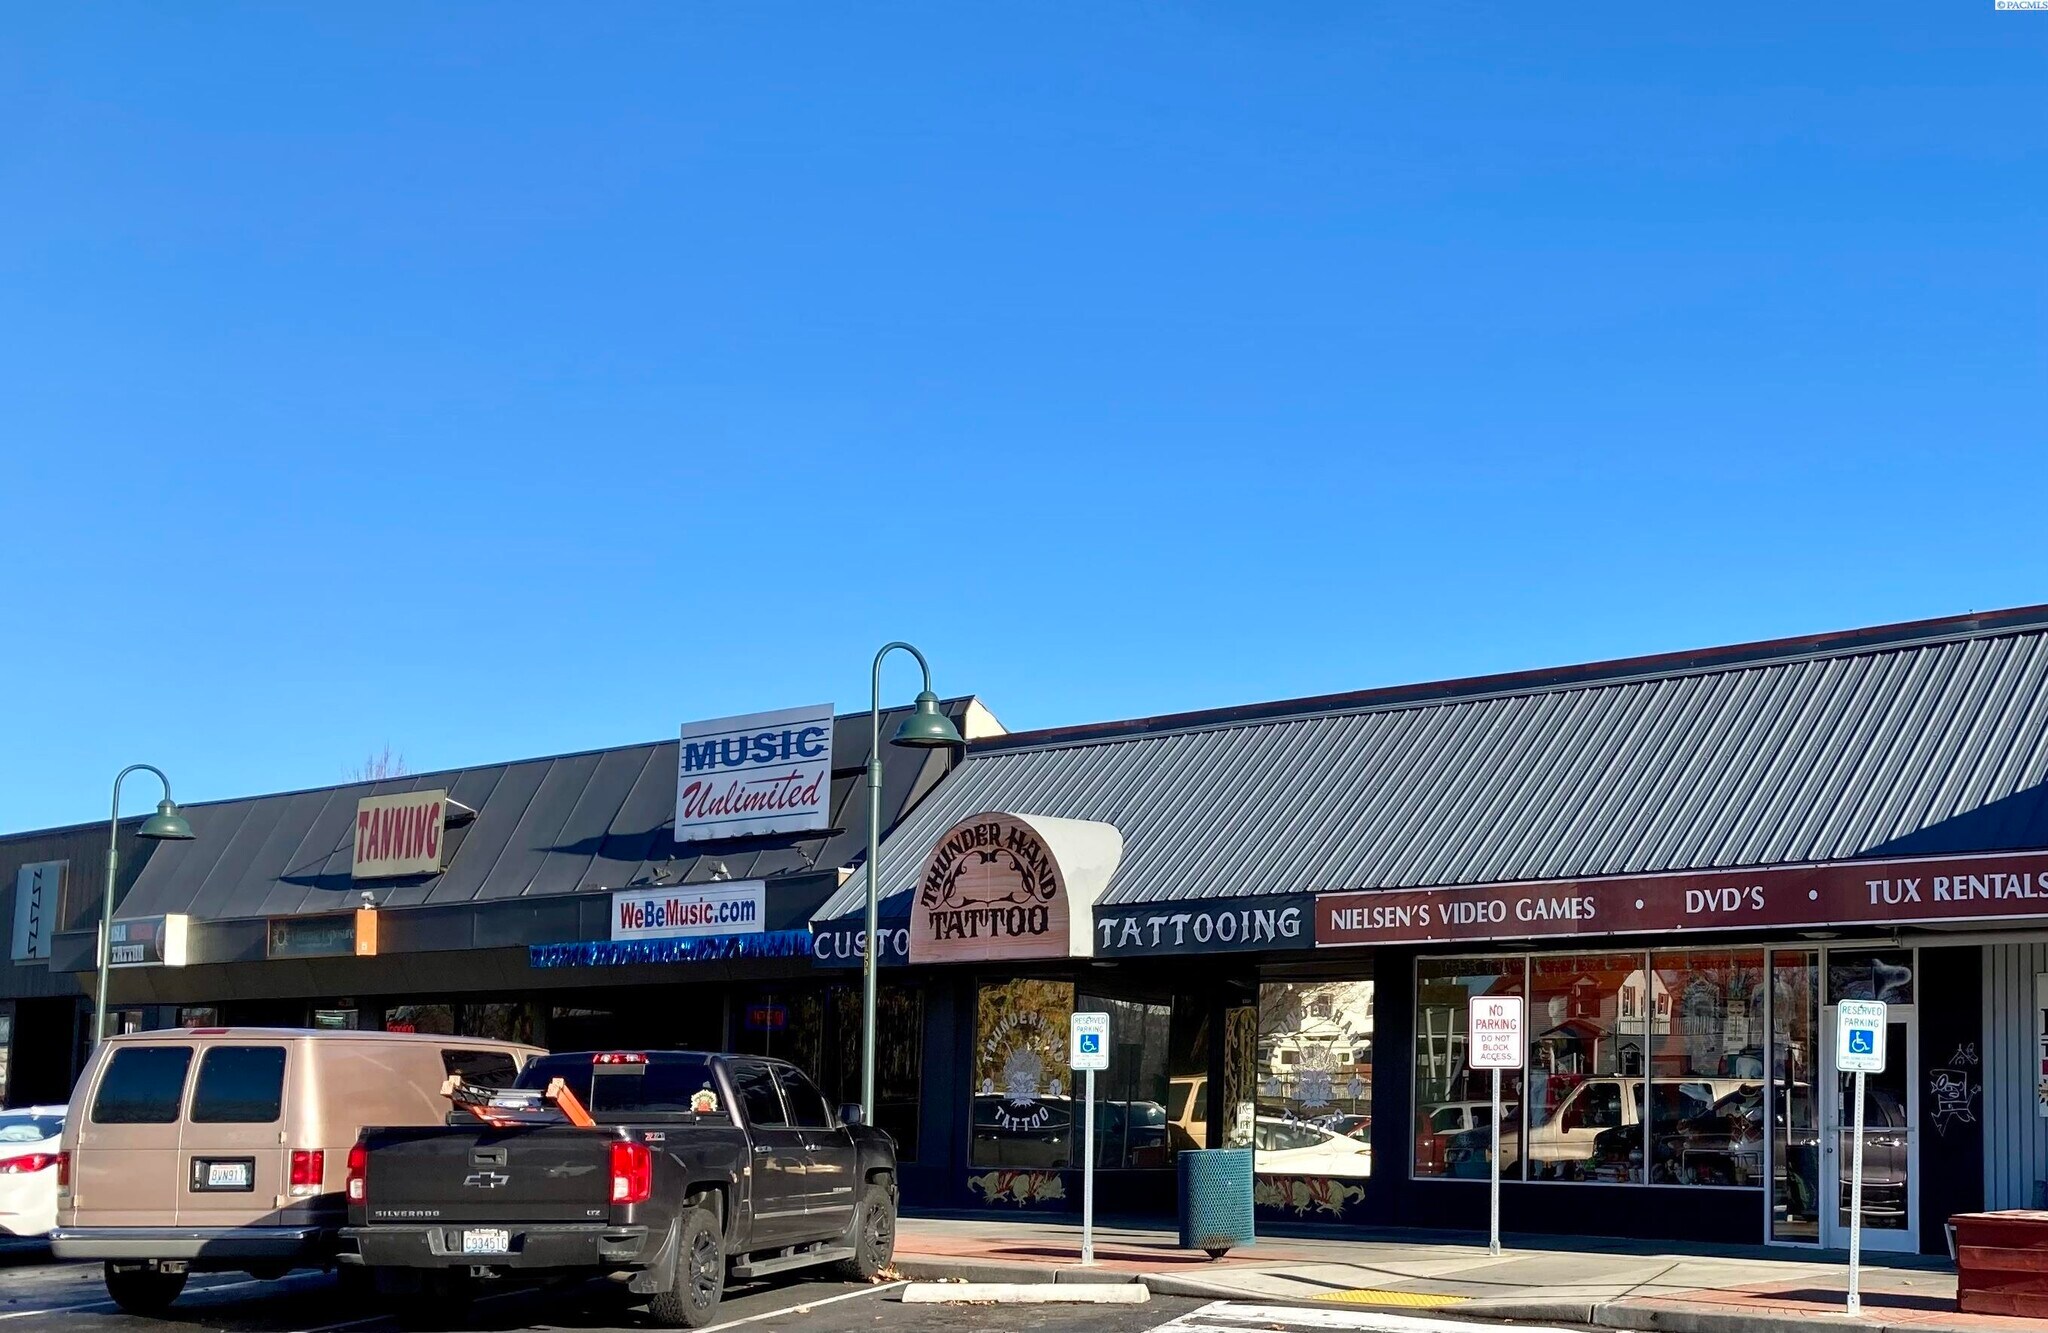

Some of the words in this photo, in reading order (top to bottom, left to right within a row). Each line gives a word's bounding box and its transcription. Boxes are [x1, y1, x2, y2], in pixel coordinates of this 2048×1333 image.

[684, 726, 825, 772] MUSIC
[682, 769, 825, 819] Unlimited
[357, 802, 440, 864] TANNING
[920, 822, 1004, 909] THUNDER
[1005, 826, 1057, 900] HAND
[1865, 878, 1922, 905] TUX
[1933, 872, 2048, 902] RENTALS
[1685, 886, 1765, 914] DVD'S
[620, 897, 756, 929] WeBeMusic.com
[928, 904, 1050, 940] TATTOO
[1330, 903, 1430, 931] NIELSEN'S
[1438, 900, 1507, 925] VIDEO
[1515, 896, 1596, 922] GAMES
[1097, 907, 1302, 949] TATTOOING
[111, 944, 145, 963] TATTOO
[1074, 1016, 1106, 1025] RESERVED
[1489, 1005, 1504, 1017] NO
[1842, 1005, 1883, 1016] RESERVED
[1076, 1025, 1104, 1033] PARKING
[1475, 1018, 1517, 1030] PARKING
[1844, 1017, 1880, 1028] PARKING
[1480, 1052, 1512, 1060] ACCESS
[1482, 1043, 1509, 1051] BLOCK
[995, 1106, 1049, 1132] TATTOO
[375, 1209, 440, 1217] SILVERADO
[465, 1236, 507, 1250] C93451G
